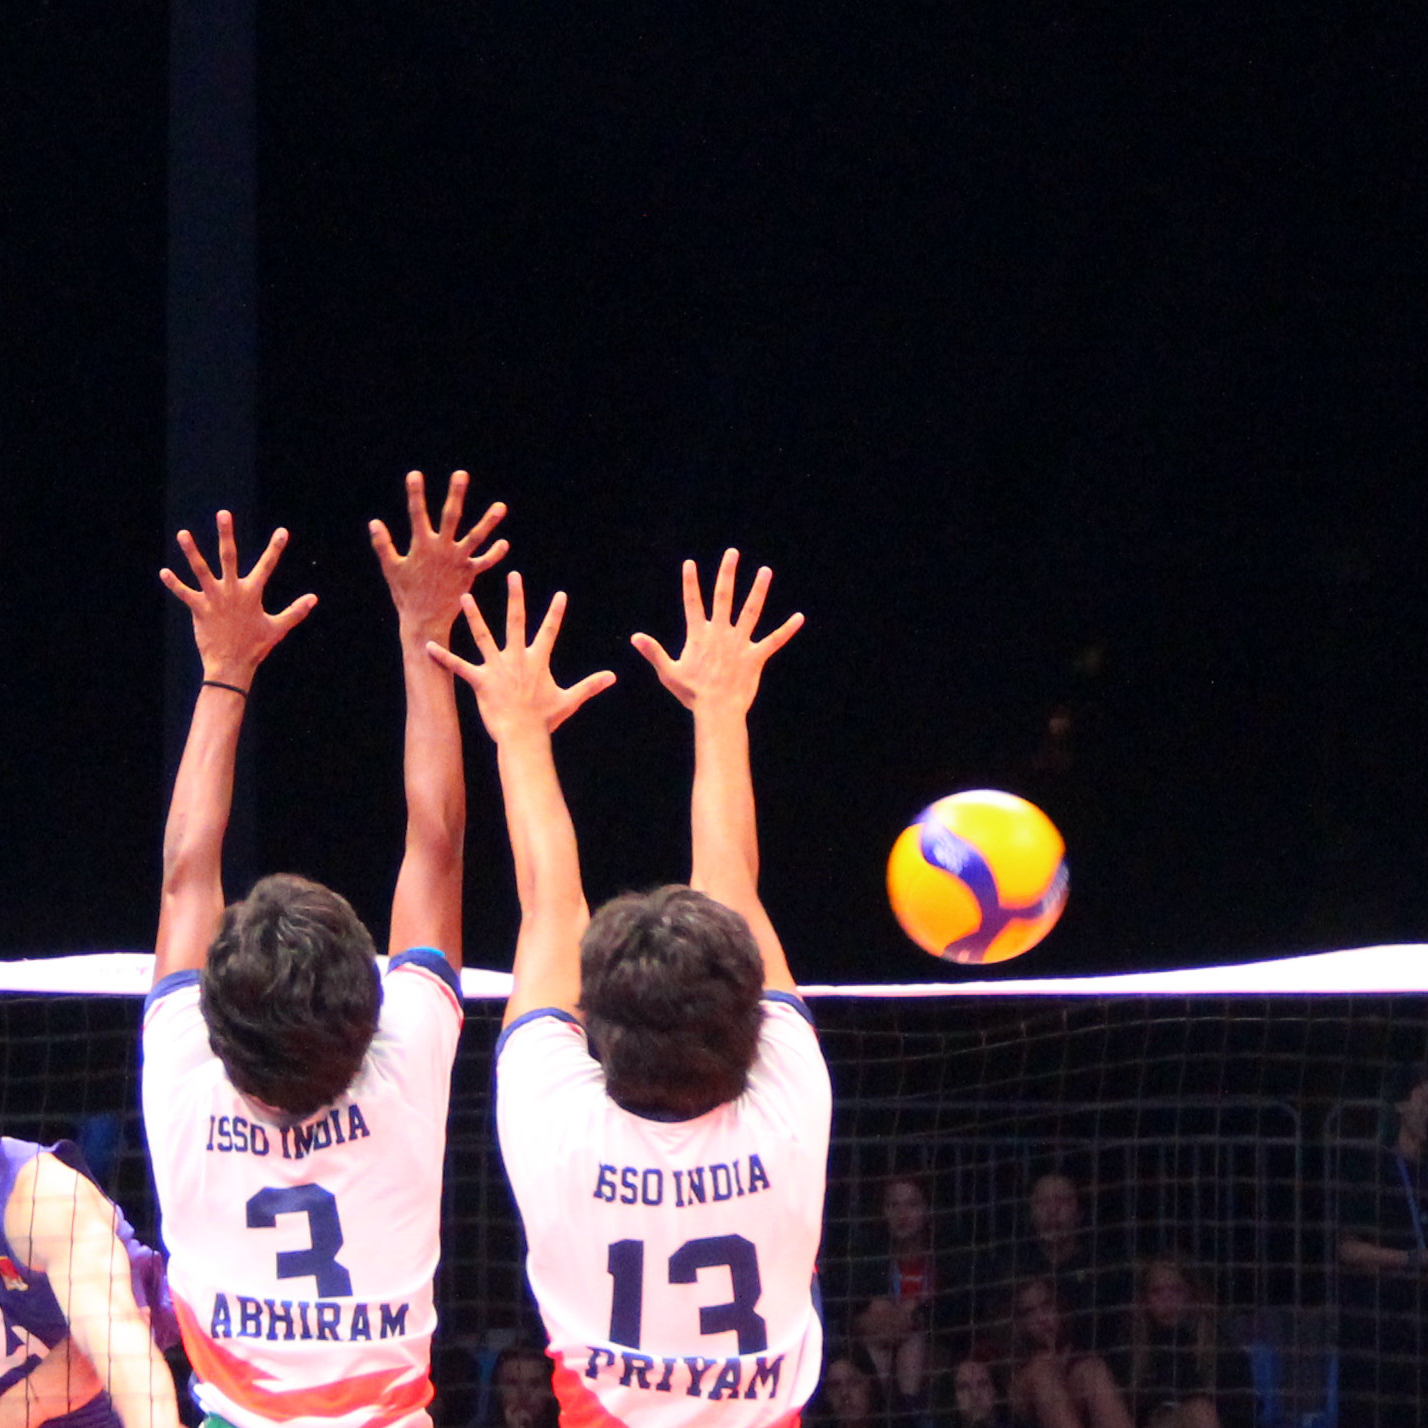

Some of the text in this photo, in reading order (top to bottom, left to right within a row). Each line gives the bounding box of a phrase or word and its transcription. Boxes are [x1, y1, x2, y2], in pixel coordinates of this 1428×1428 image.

[207, 1104, 370, 1160] ISSO INDIA
[673, 1154, 770, 1208] INDIA
[246, 1183, 353, 1299] 3
[211, 1293, 409, 1341] ABHIRAM
[608, 1233, 768, 1356] 13
[585, 1345, 785, 1401] PRIYAM
